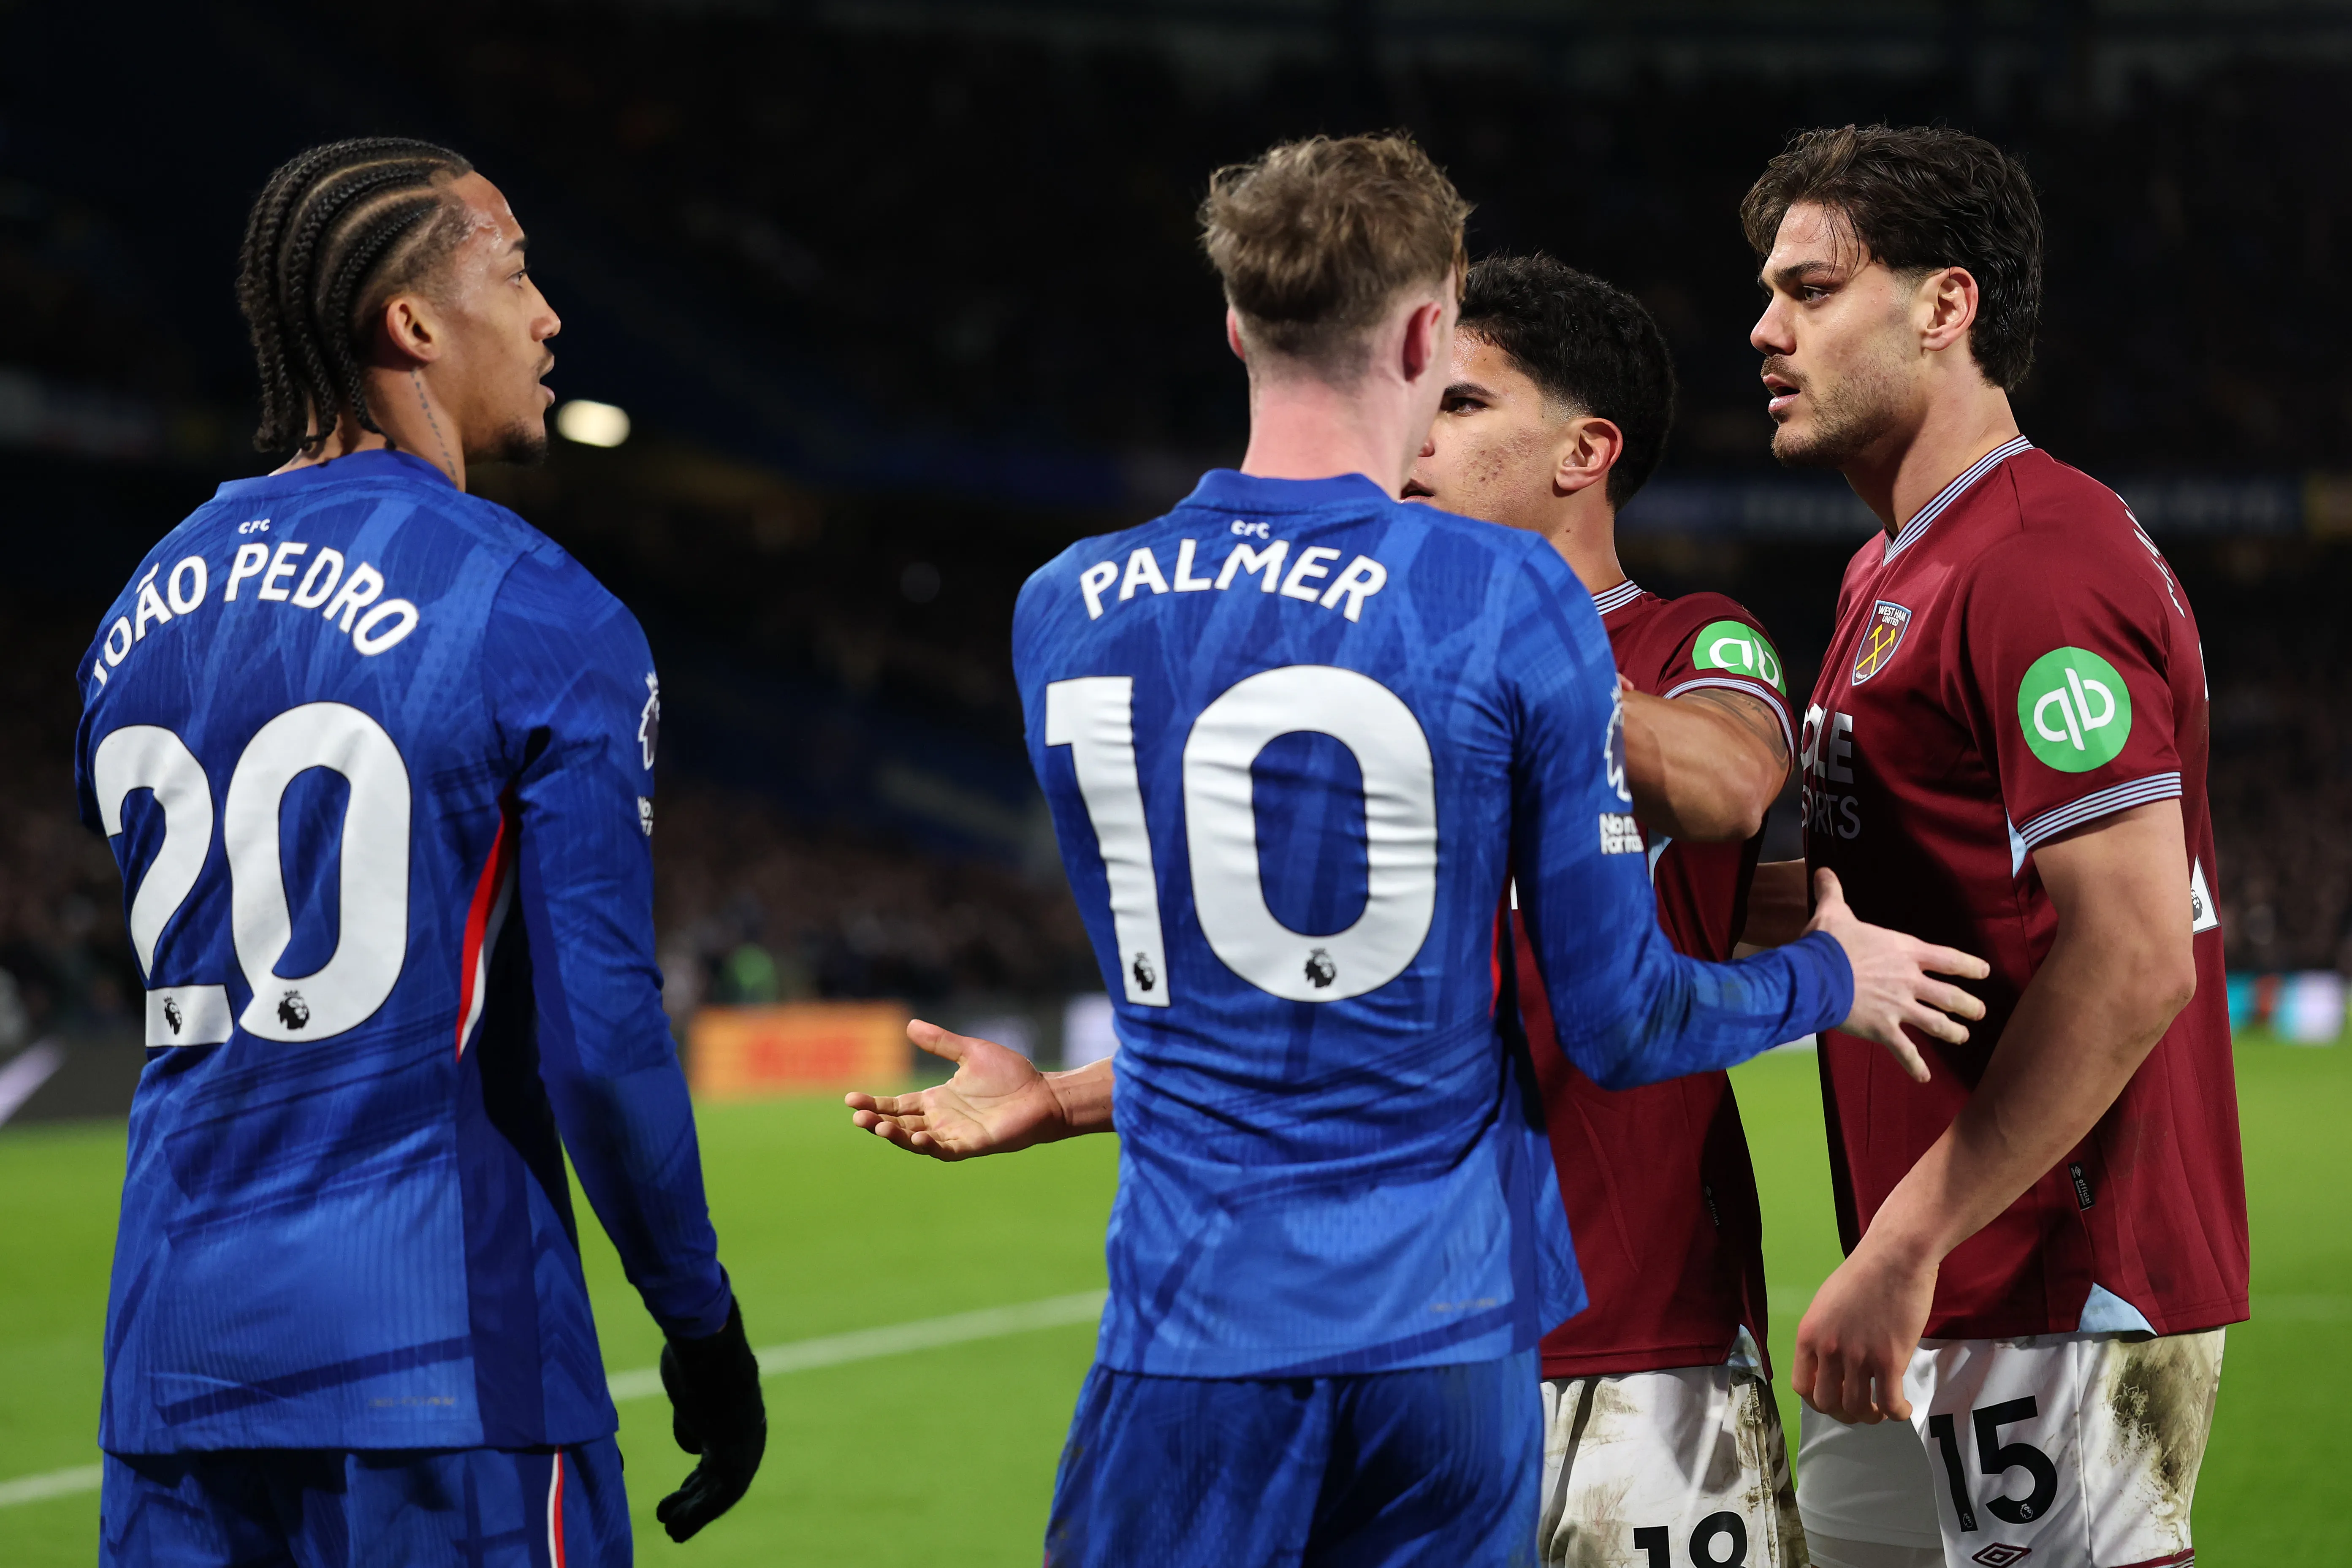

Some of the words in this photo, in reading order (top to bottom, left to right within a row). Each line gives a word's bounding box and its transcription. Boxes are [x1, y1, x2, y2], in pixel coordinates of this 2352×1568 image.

[238, 518, 271, 535] CFC
[1230, 519, 1270, 540] CFC
[225, 541, 419, 656] PEDRO
[1080, 538, 1388, 623] PALMER
[1878, 606, 1895, 617] WEST
[1895, 610, 1907, 622] HAM
[1882, 616, 1899, 626] UNITED
[1045, 664, 1438, 1007] 10
[94, 701, 412, 1048] 20
[2079, 1180, 2091, 1204] official
[1929, 1395, 2058, 1533] 15
